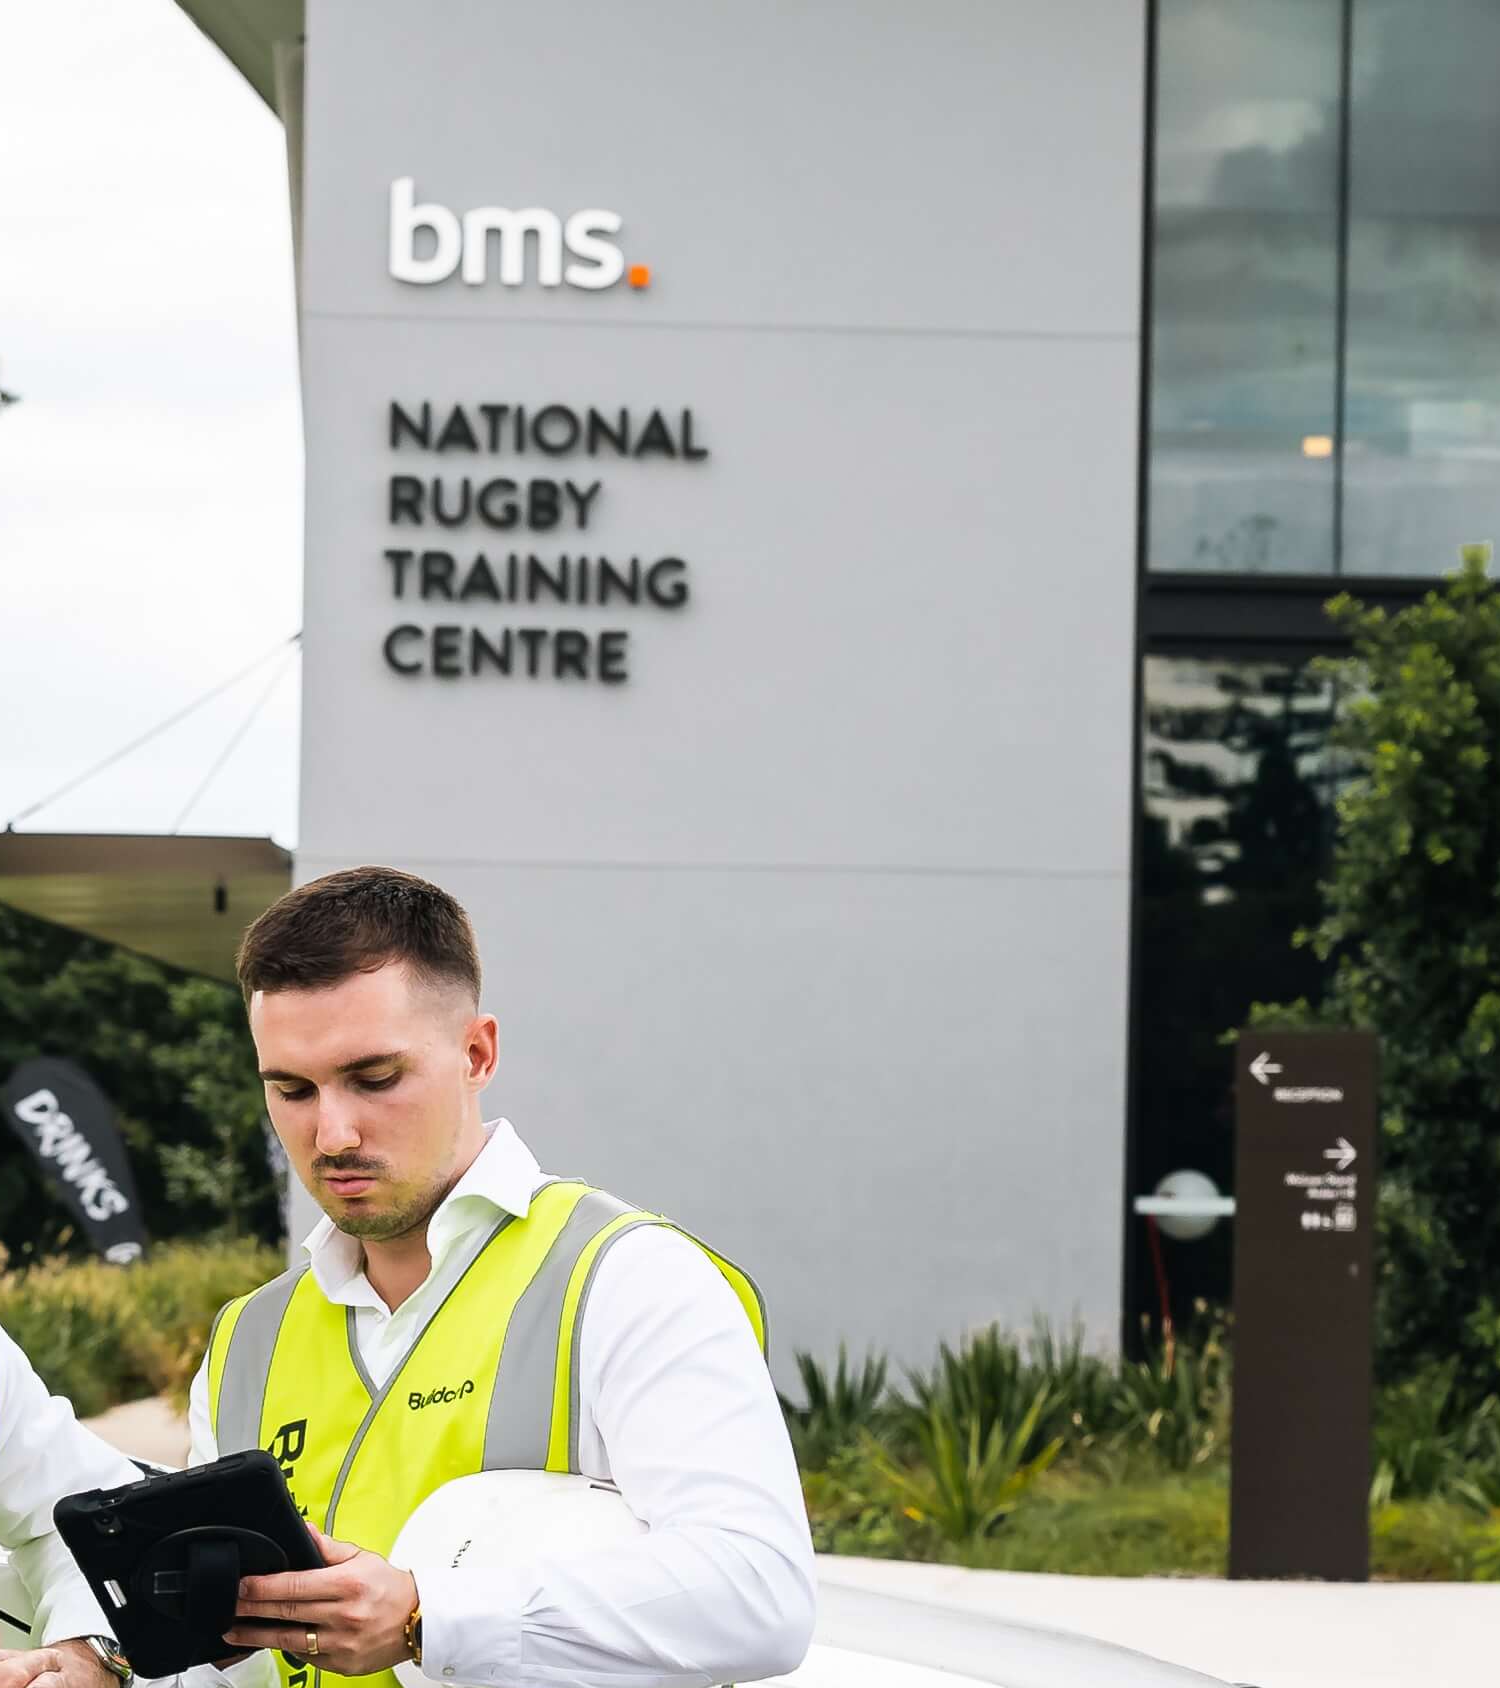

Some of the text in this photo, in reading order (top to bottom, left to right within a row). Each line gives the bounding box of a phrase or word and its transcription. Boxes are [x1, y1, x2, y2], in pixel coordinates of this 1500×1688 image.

[389, 400, 709, 463] NATIONAL
[388, 474, 603, 534] RUGBY
[382, 548, 690, 612] TRAINING
[382, 623, 630, 687] CENTRE
[14, 1088, 130, 1221] DRINKS
